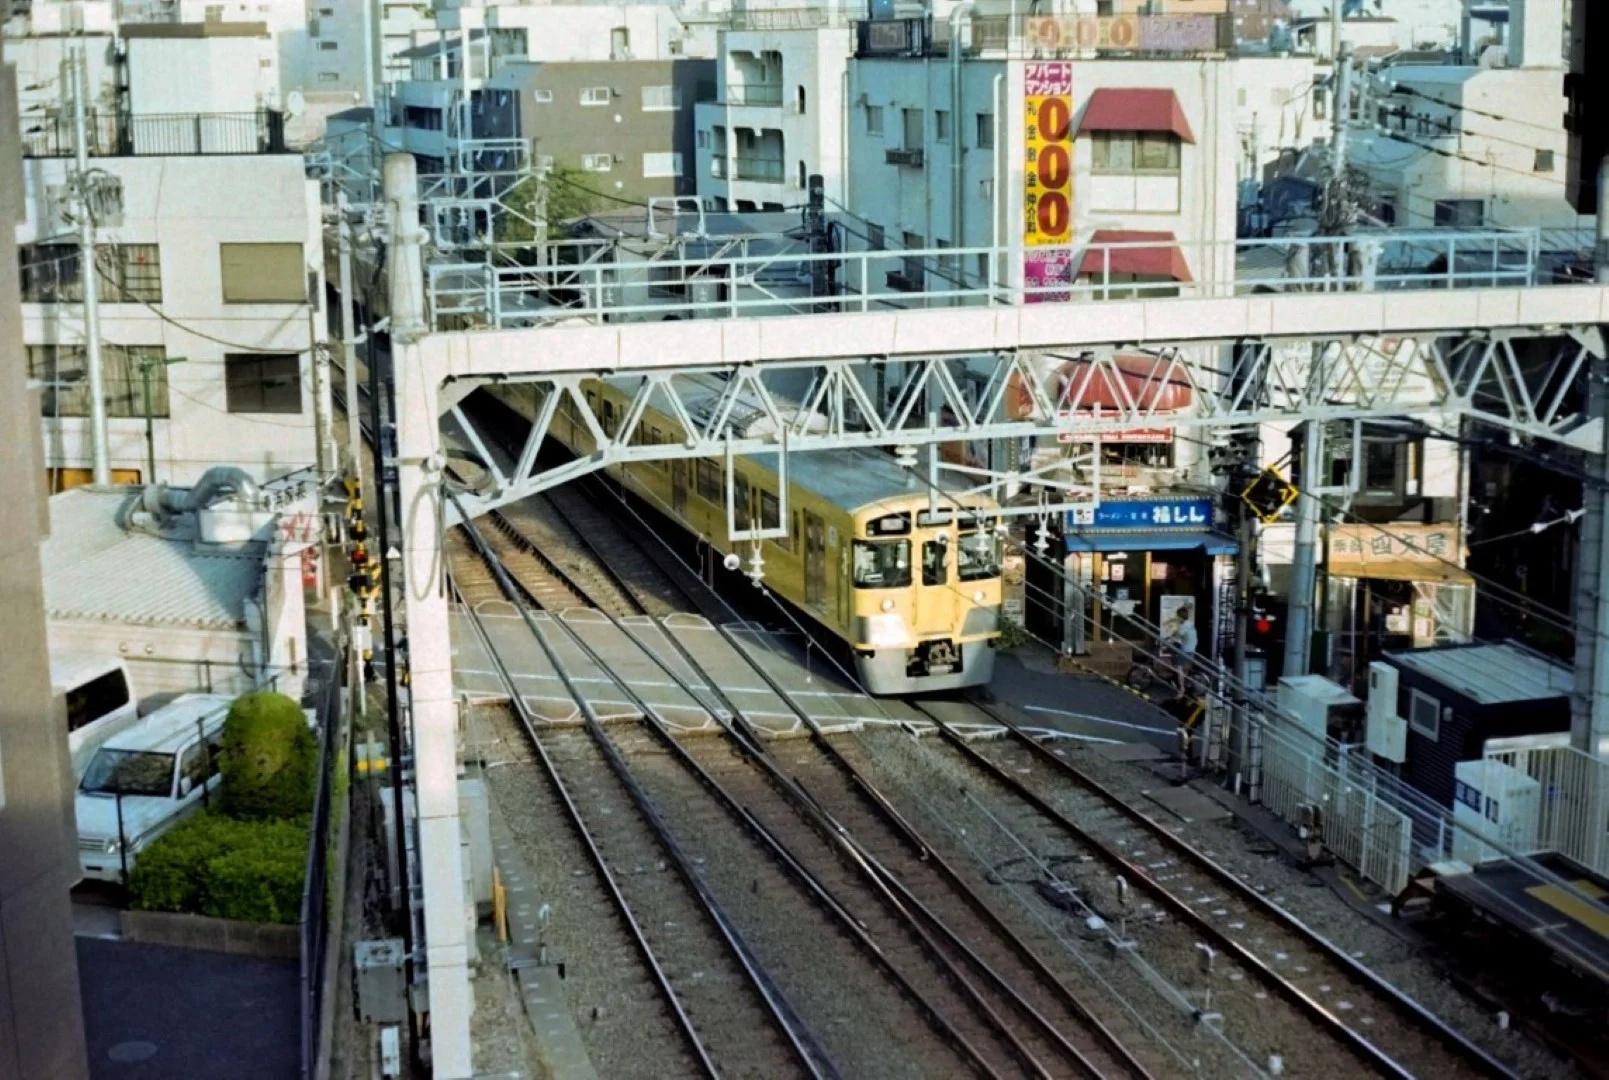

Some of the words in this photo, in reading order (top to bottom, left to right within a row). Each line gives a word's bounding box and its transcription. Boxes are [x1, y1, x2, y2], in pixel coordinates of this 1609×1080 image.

[1025, 64, 1071, 79] アパート
[1025, 80, 1071, 95] マンション
[1152, 505, 1206, 524] 福しん
